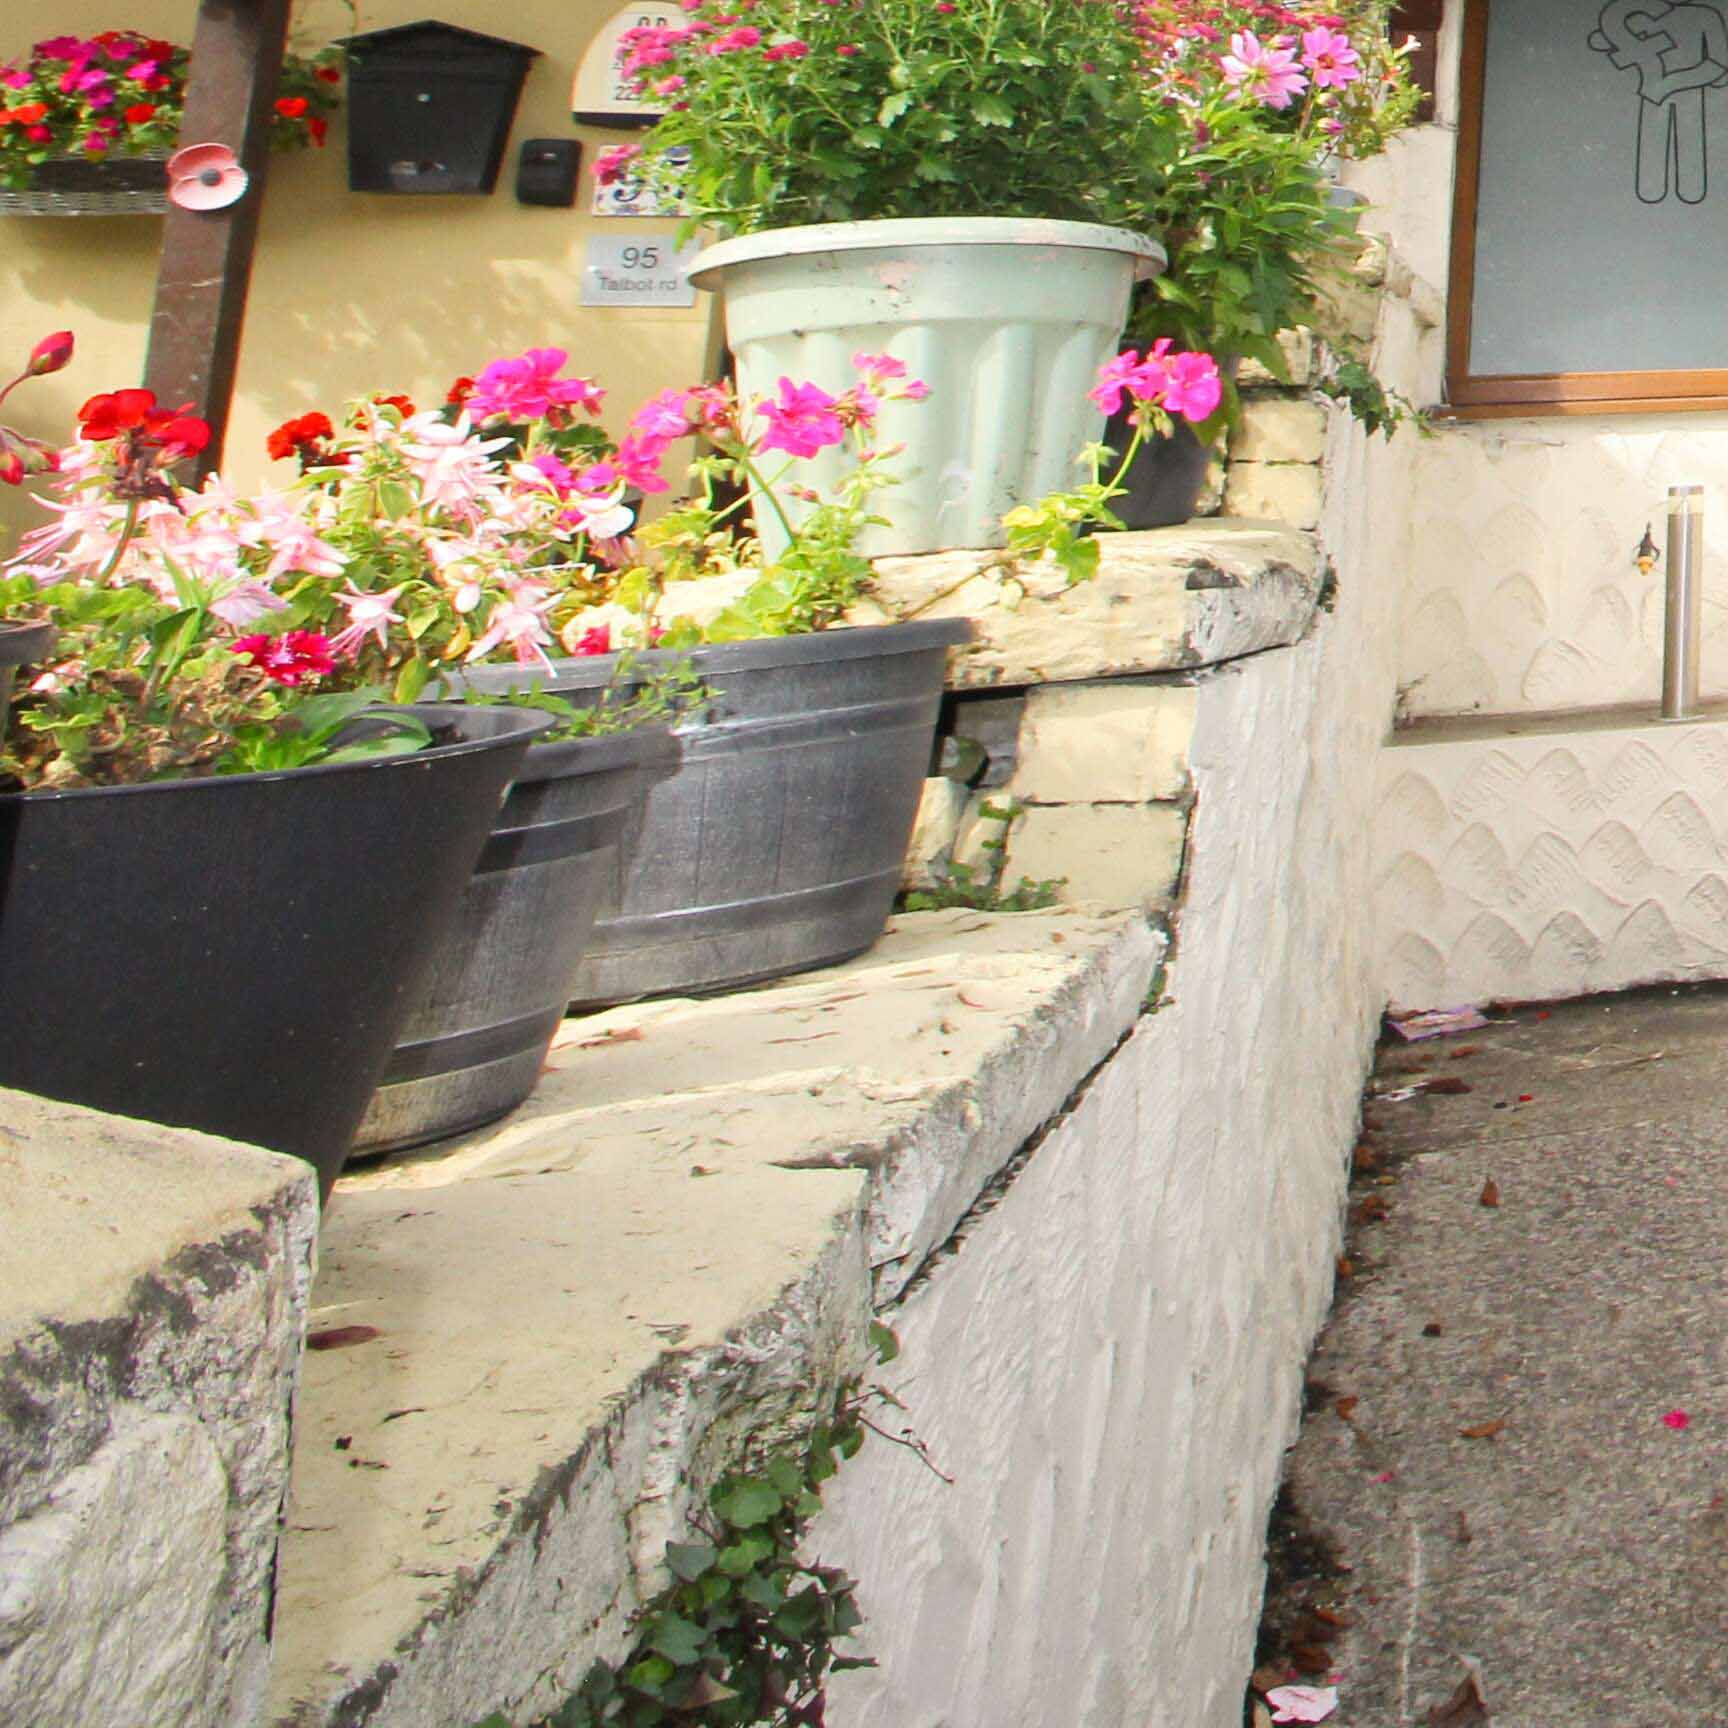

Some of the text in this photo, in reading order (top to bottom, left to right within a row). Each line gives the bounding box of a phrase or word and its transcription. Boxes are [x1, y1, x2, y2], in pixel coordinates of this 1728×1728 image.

[621, 246, 660, 270] 95
[599, 276, 678, 291] Talbot rd
